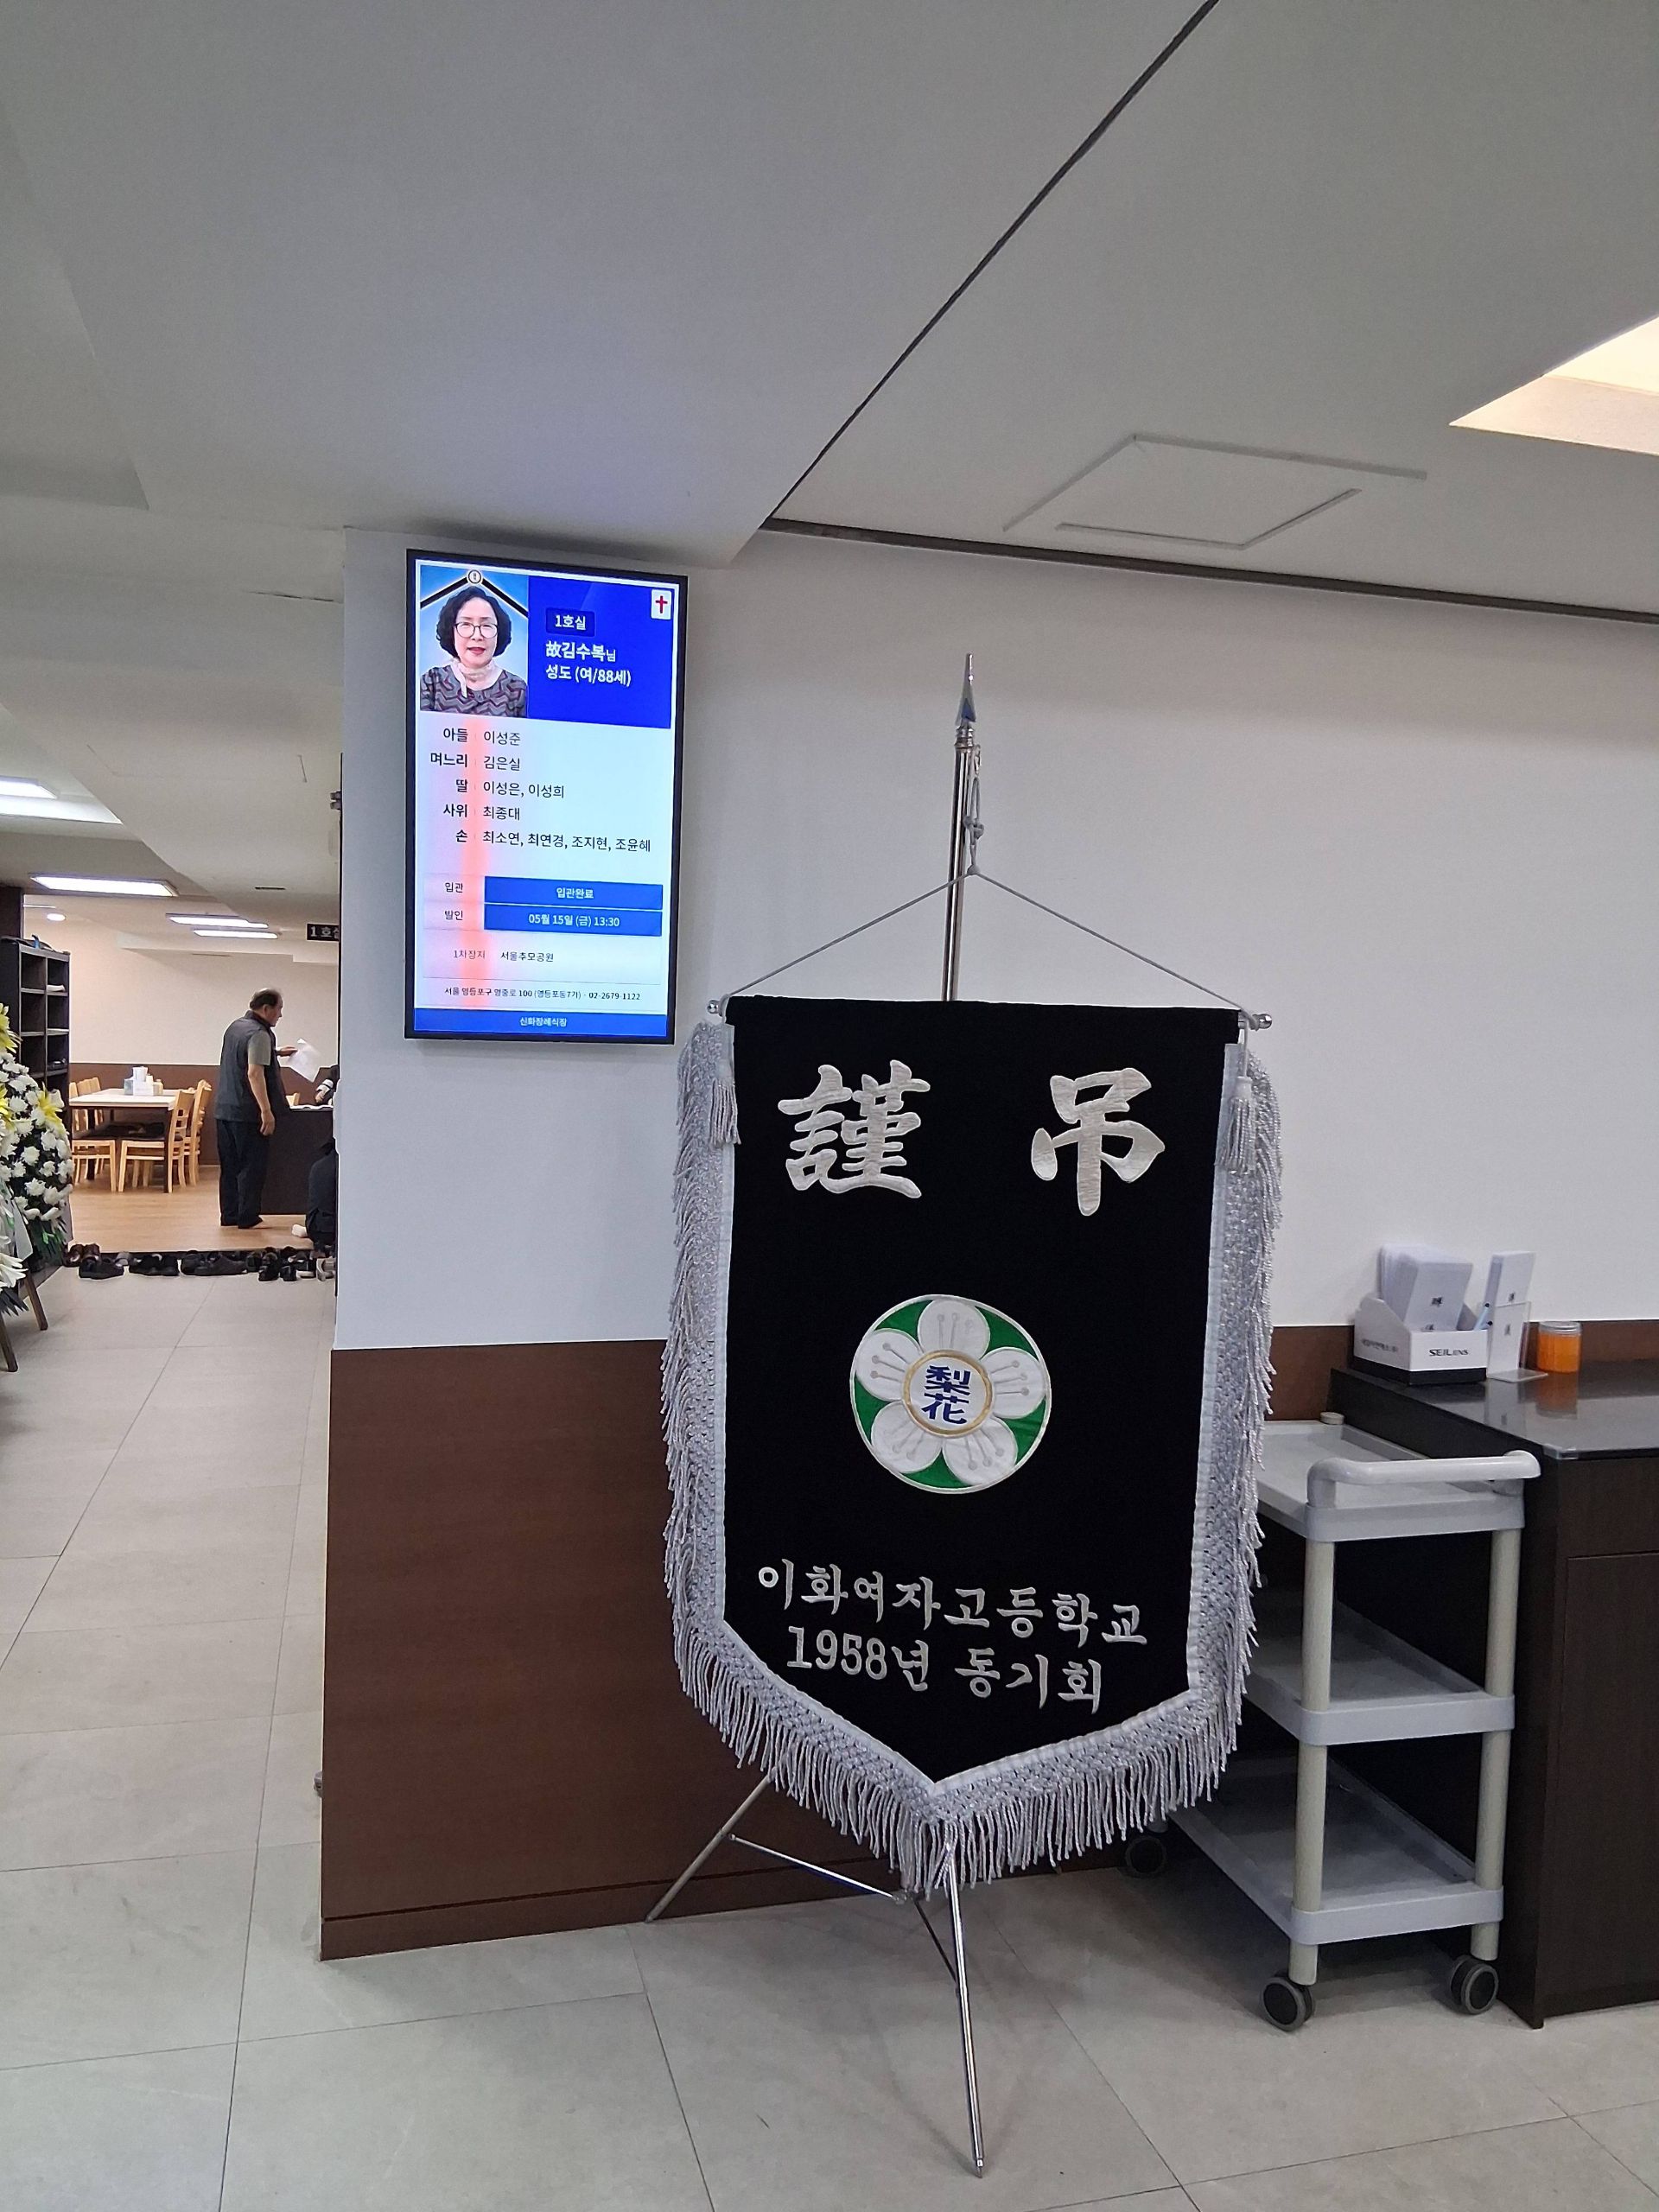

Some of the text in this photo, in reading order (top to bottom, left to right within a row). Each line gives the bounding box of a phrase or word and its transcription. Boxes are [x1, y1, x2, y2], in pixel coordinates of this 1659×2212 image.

[555, 614, 587, 631] 1호실
[545, 640, 616, 663] 故김수복님
[545, 664, 632, 688] 성도 (여/88세)
[443, 728, 521, 746] 아들 이성준
[430, 752, 521, 771] 며느리 김은실
[456, 779, 564, 798] 딸 이성은, 이성희
[443, 804, 520, 821] 사위 최종대
[456, 830, 651, 853] 손 최소연, 최연경, 조지현, 조윤혜
[444, 882, 594, 899] 입관 입관완료
[444, 910, 620, 928] 발인 05월 15일 (금) 13:30
[758, 1558, 1147, 1649] 이화여자고등학교
[786, 1625, 1103, 1714] 1958년 동기회
